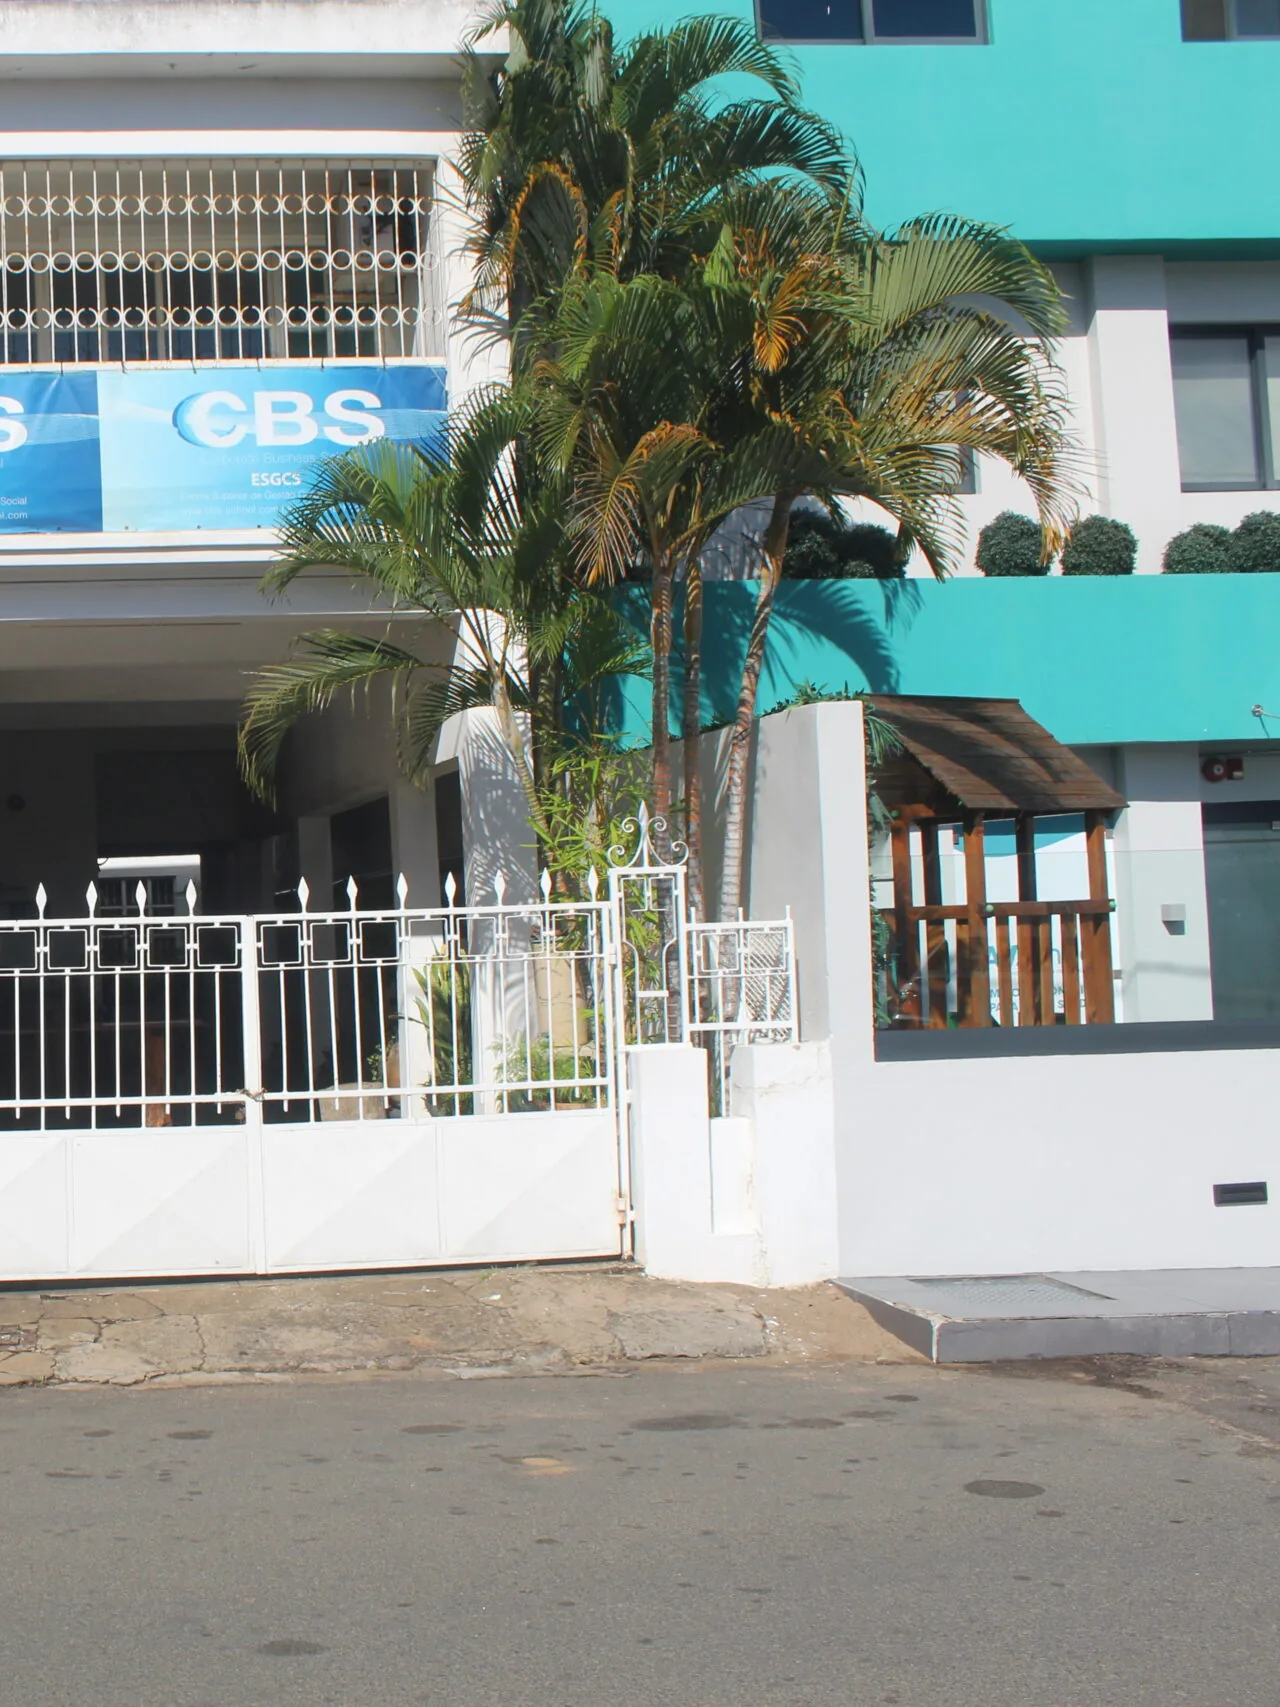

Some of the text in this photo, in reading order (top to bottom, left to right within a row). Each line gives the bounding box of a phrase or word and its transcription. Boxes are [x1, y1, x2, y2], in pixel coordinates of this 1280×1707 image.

[187, 389, 386, 449] CBS
[251, 472, 303, 487] ESGCS
[0, 495, 28, 506] Social
